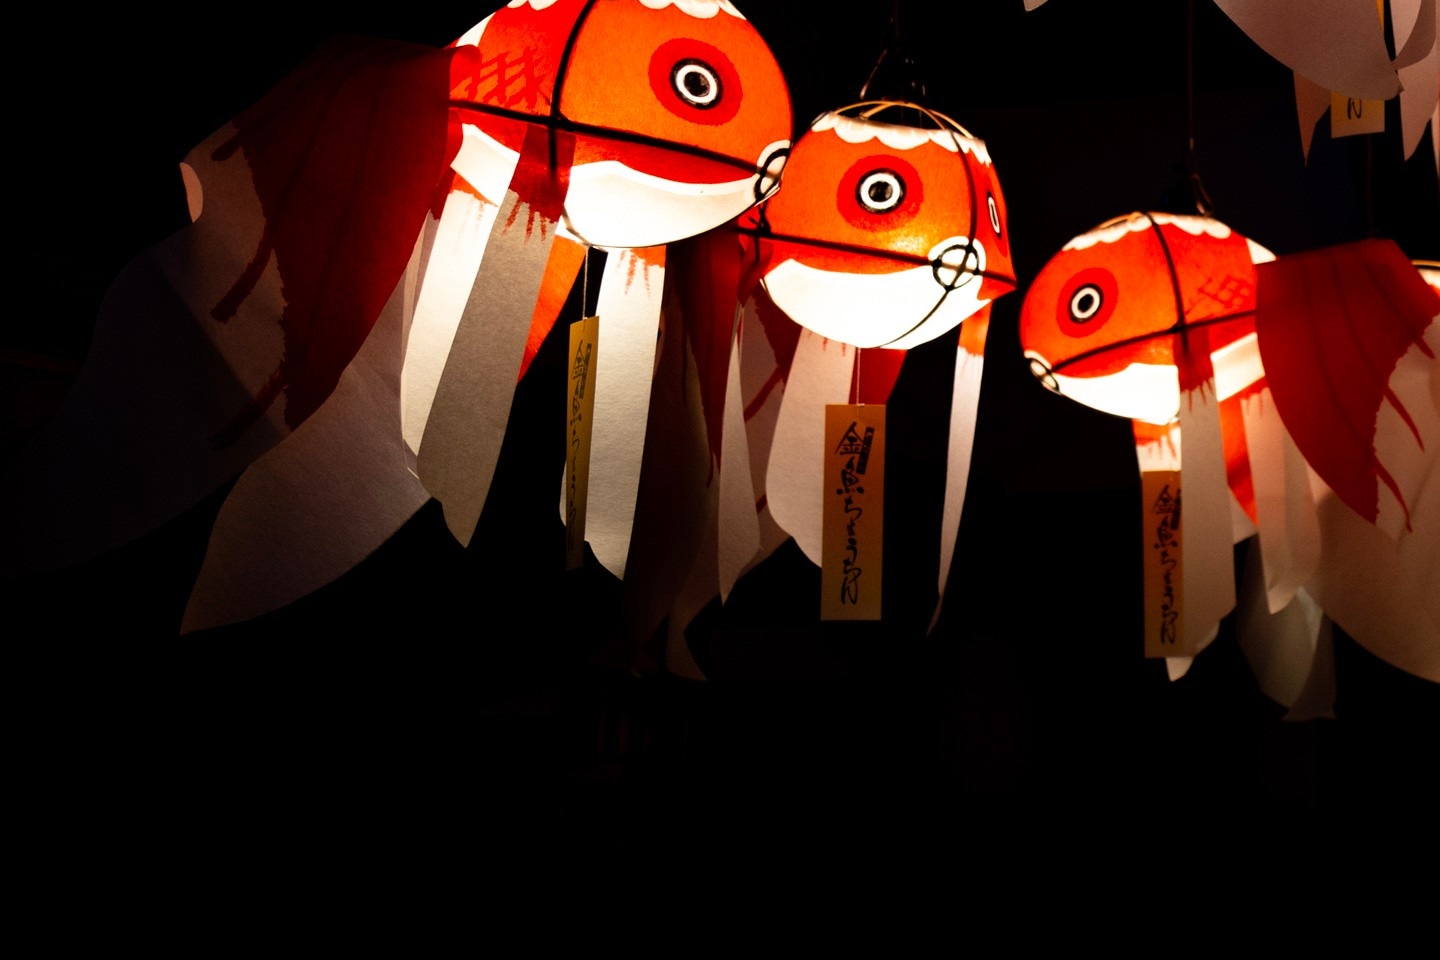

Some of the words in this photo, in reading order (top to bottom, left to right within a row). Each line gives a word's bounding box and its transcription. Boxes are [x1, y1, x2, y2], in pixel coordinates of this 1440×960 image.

[835, 421, 864, 605] 金魚ちょうちん
